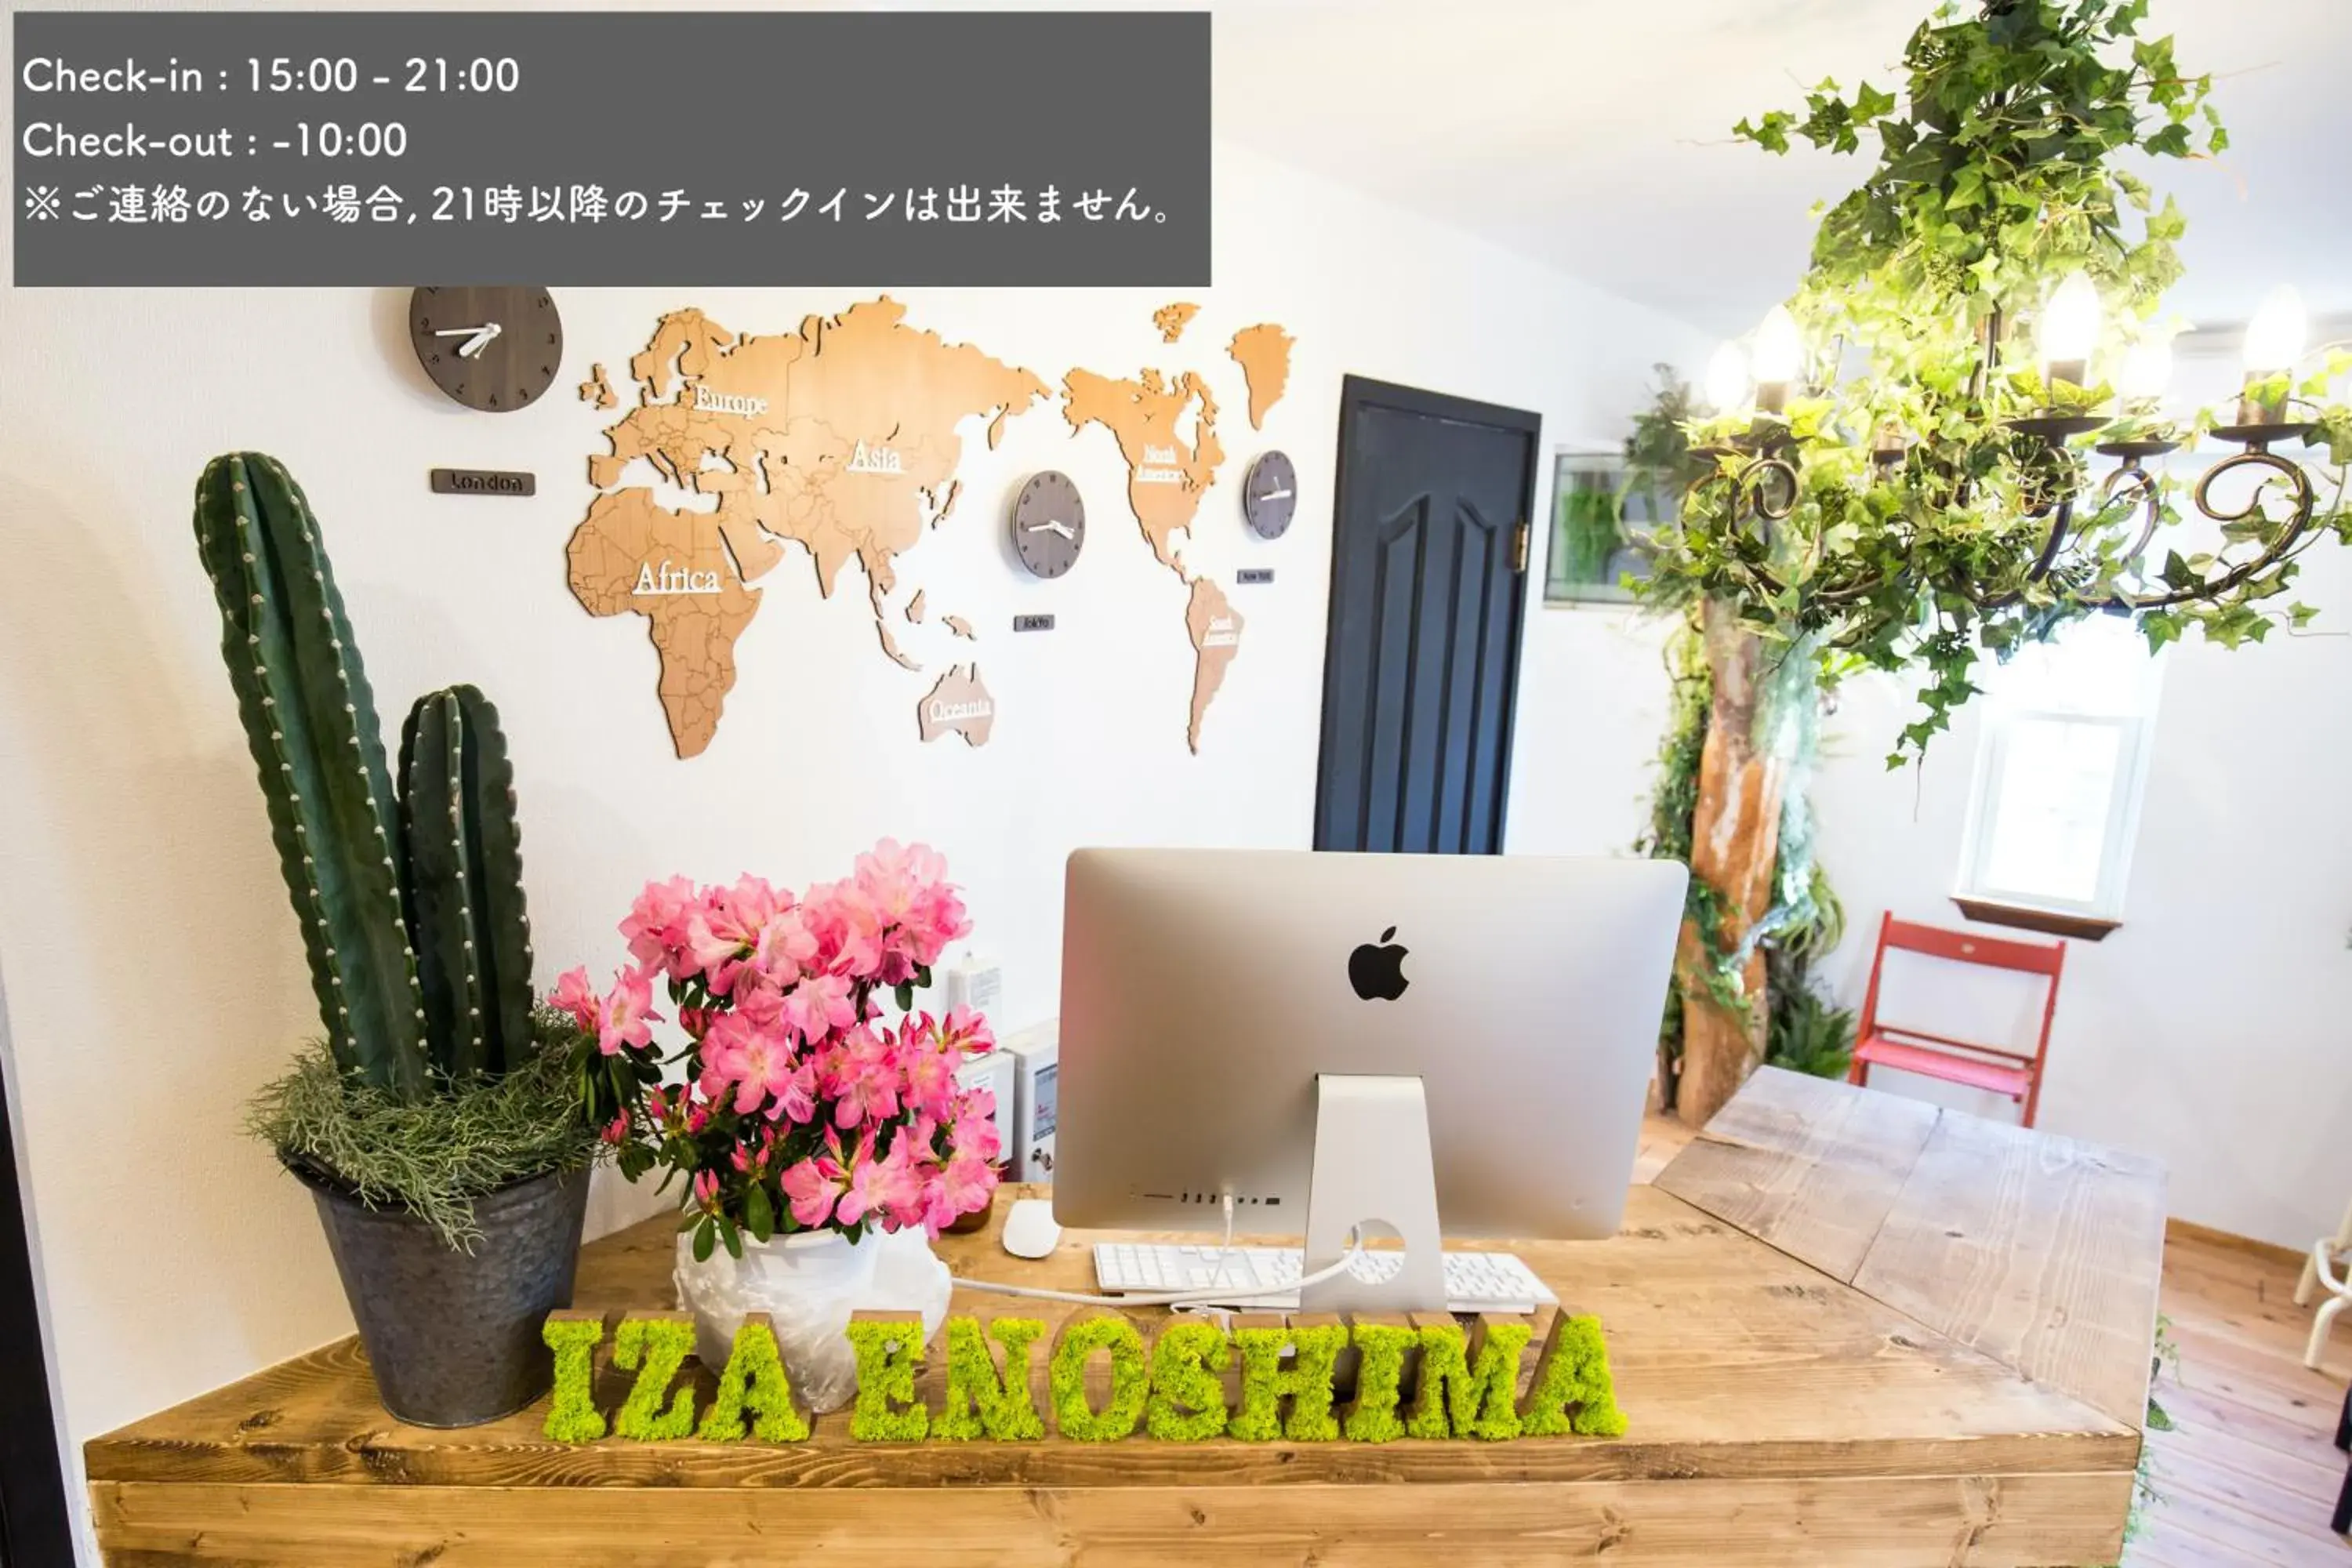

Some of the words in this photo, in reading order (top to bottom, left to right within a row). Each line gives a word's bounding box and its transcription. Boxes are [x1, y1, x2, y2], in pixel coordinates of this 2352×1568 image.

[693, 385, 768, 421] Europe
[846, 437, 906, 474] Asia
[451, 471, 523, 492] London
[632, 560, 723, 595] Africa
[543, 1311, 811, 1444] IZA
[847, 1308, 1628, 1444] ENOSHIMA
